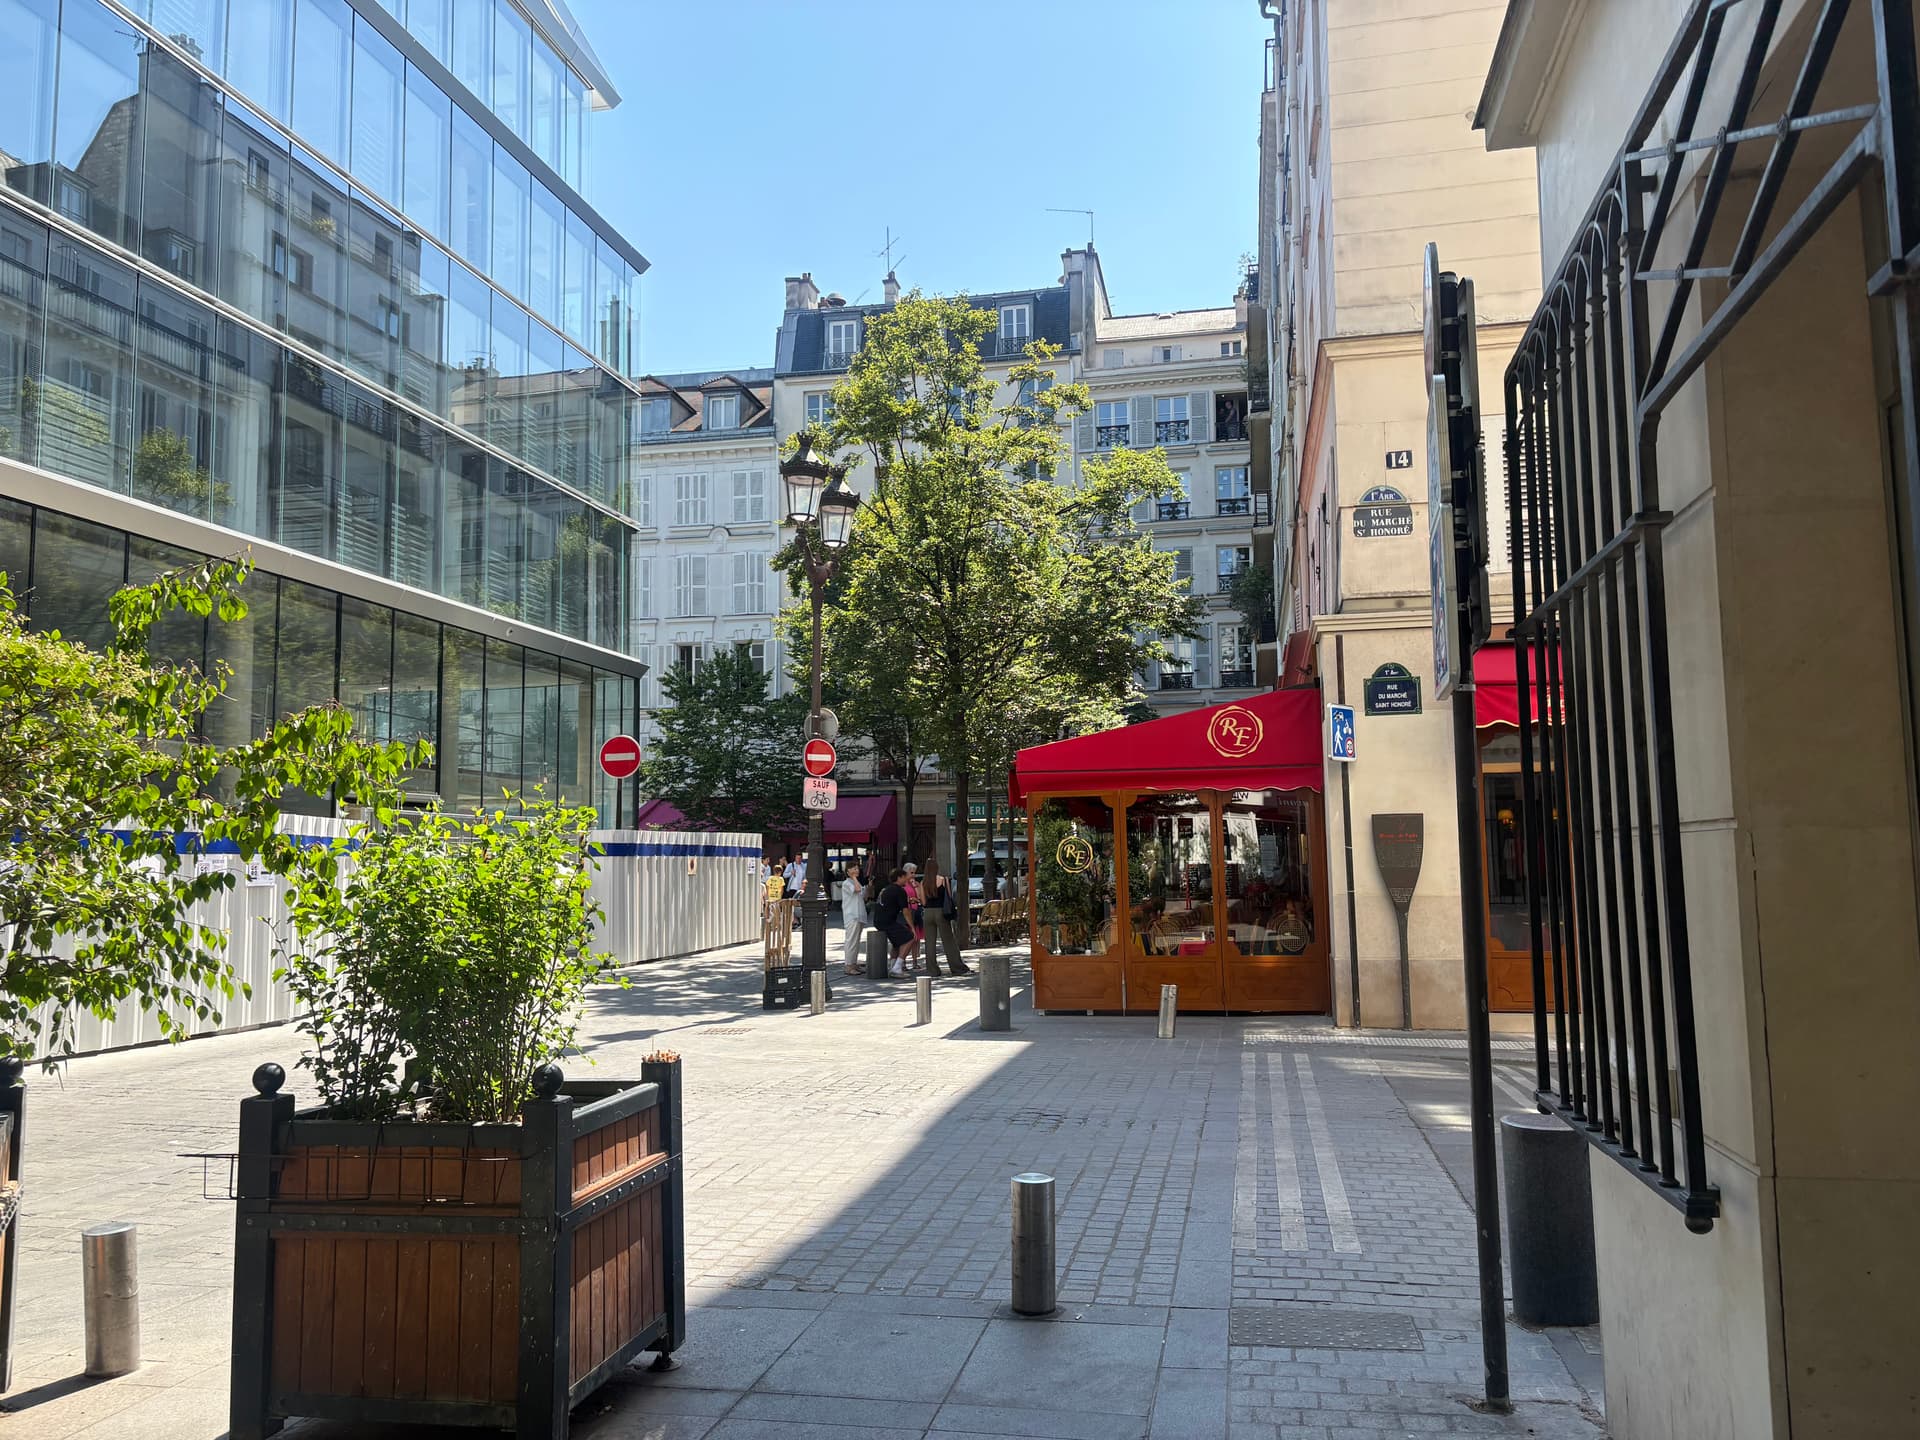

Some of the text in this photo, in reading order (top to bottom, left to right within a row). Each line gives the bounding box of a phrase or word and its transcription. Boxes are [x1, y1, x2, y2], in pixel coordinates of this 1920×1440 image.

[1391, 452, 1408, 468] 14
[1371, 508, 1392, 517] RUE
[1354, 519, 1366, 527] DU
[1371, 525, 1410, 536] HONORÉ
[1219, 717, 1252, 747] RE
[812, 780, 830, 789] SAUF
[1063, 844, 1086, 866] RE
